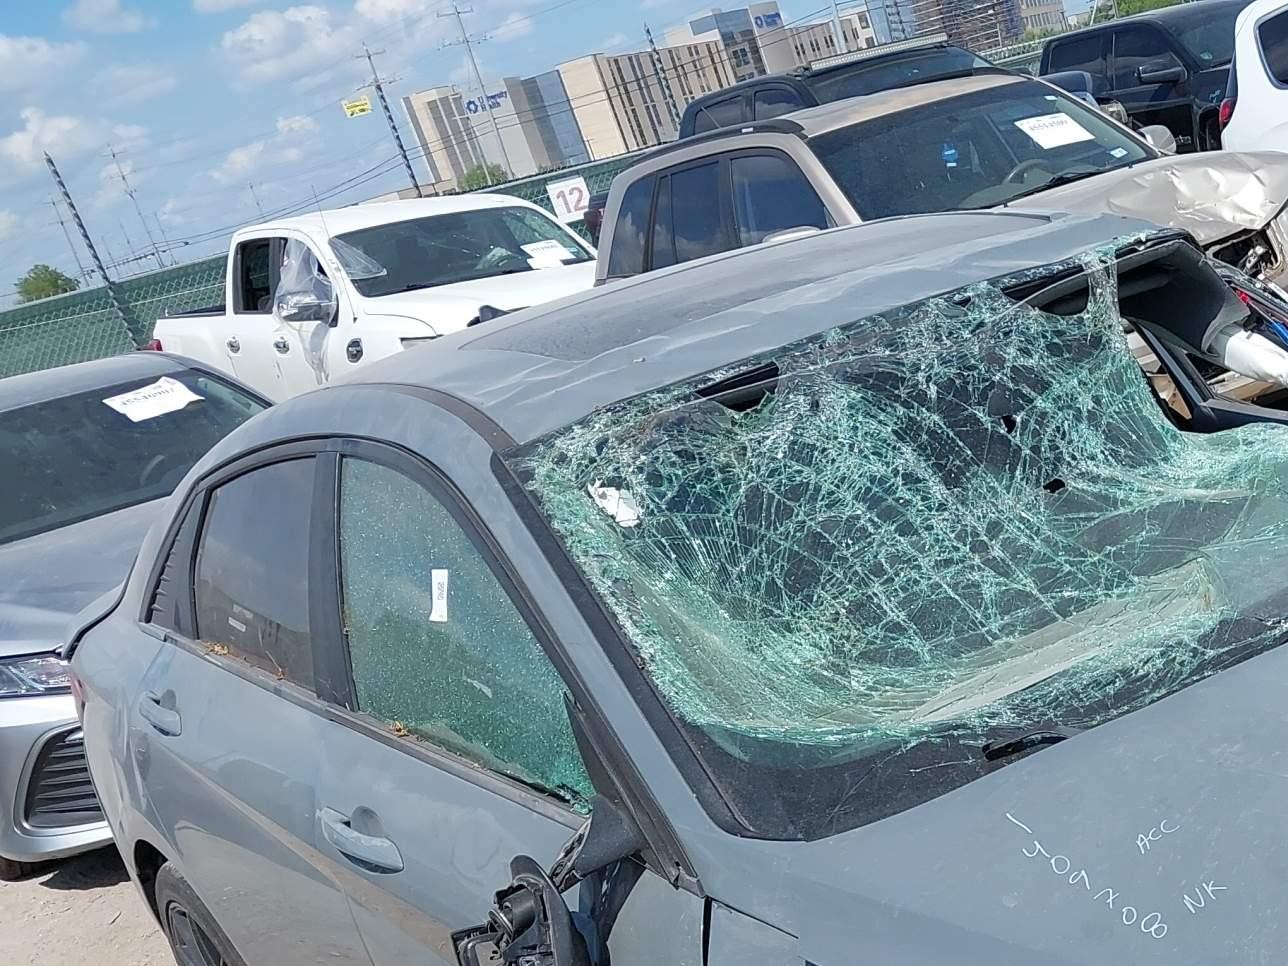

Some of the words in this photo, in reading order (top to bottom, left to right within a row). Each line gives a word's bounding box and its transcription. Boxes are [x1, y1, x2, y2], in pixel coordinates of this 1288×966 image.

[556, 186, 588, 214] 12
[1136, 819, 1181, 854] ACC
[1182, 880, 1228, 914] NK
